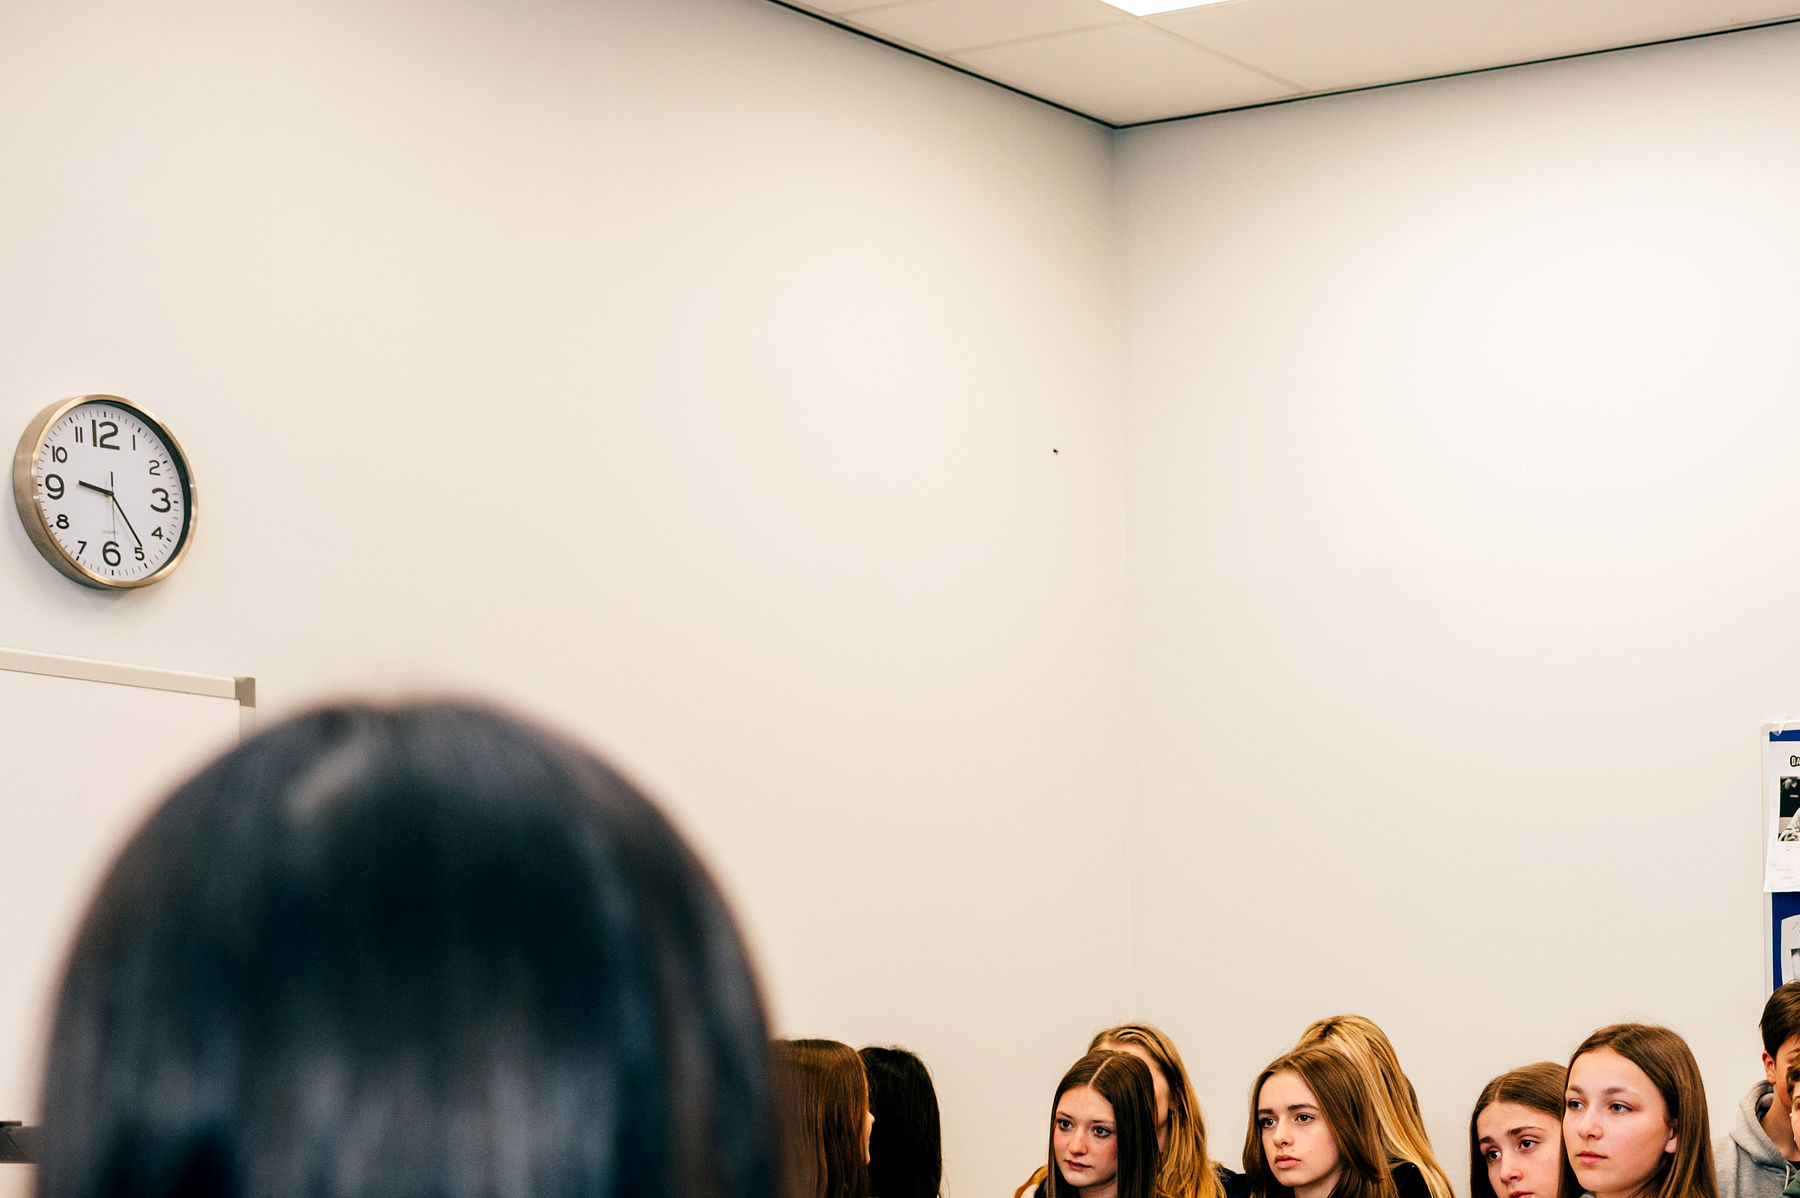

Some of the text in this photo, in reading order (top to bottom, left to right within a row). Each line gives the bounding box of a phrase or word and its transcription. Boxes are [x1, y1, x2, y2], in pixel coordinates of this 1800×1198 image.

[74, 426, 83, 443] 11
[91, 419, 120, 450] 12
[51, 445, 68, 464] 10
[149, 460, 160, 476] 2
[45, 473, 65, 500] 9
[150, 488, 171, 513] 3
[56, 514, 70, 530] 8
[151, 526, 164, 540] 4
[77, 540, 88, 555] 7
[102, 541, 121, 566] 6
[134, 546, 145, 561] 5
